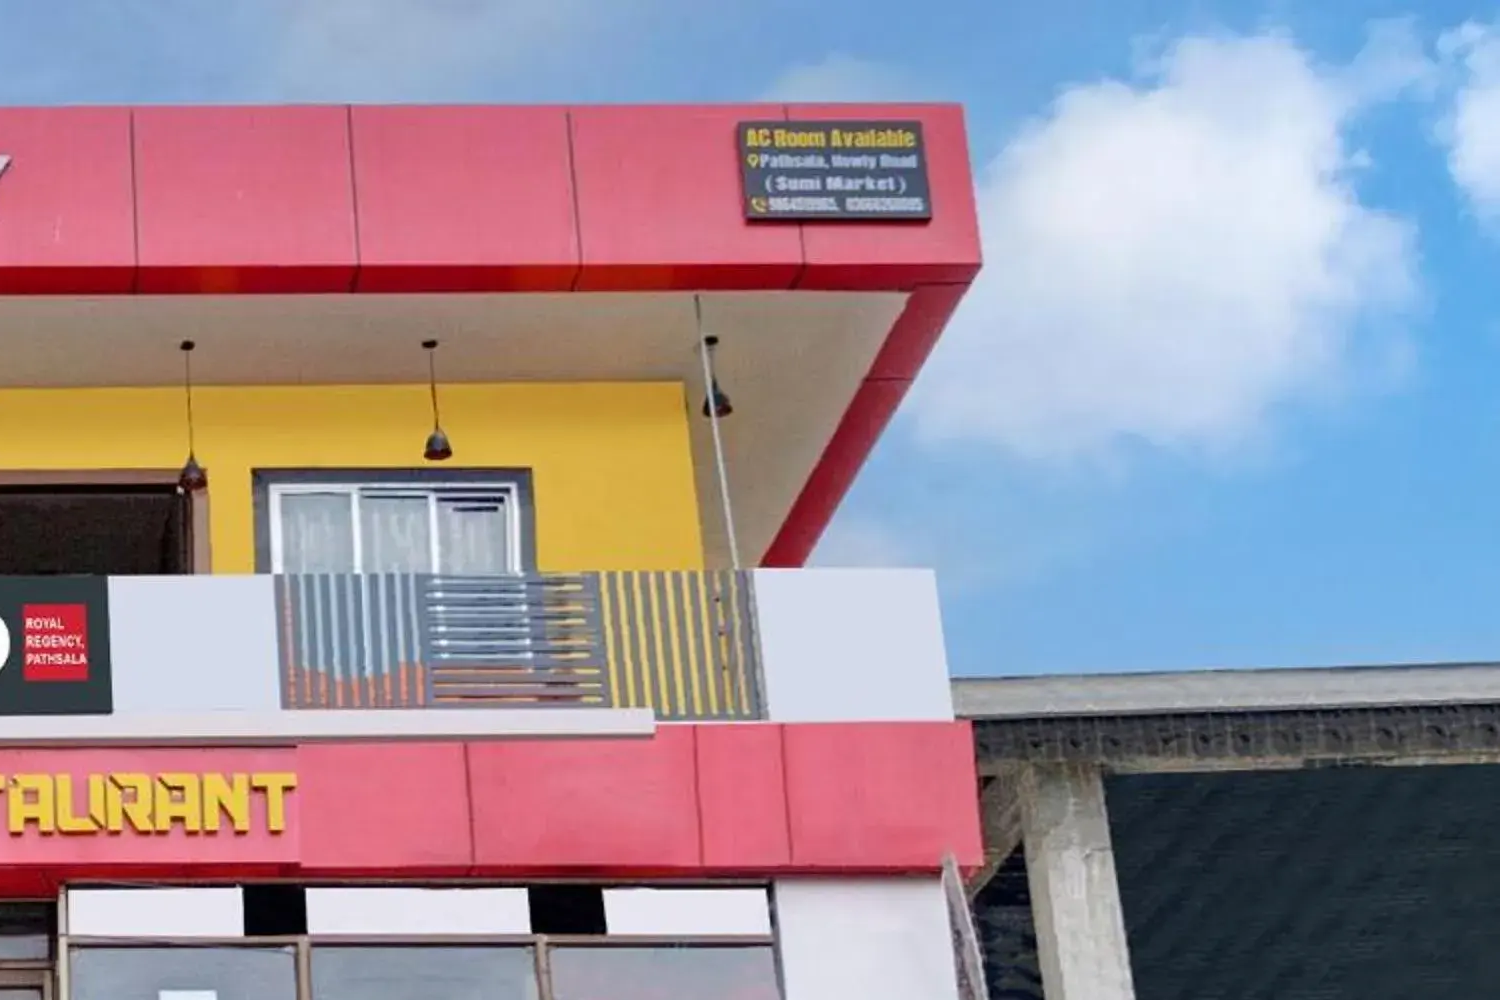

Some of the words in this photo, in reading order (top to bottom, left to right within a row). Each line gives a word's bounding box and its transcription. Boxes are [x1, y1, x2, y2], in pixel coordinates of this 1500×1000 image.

[747, 129, 771, 147] AC
[774, 129, 825, 147] Room
[831, 128, 916, 147] Available
[25, 617, 65, 630] ROYAL
[25, 635, 85, 649] REGENCY,
[25, 653, 88, 665] PATHSALA
